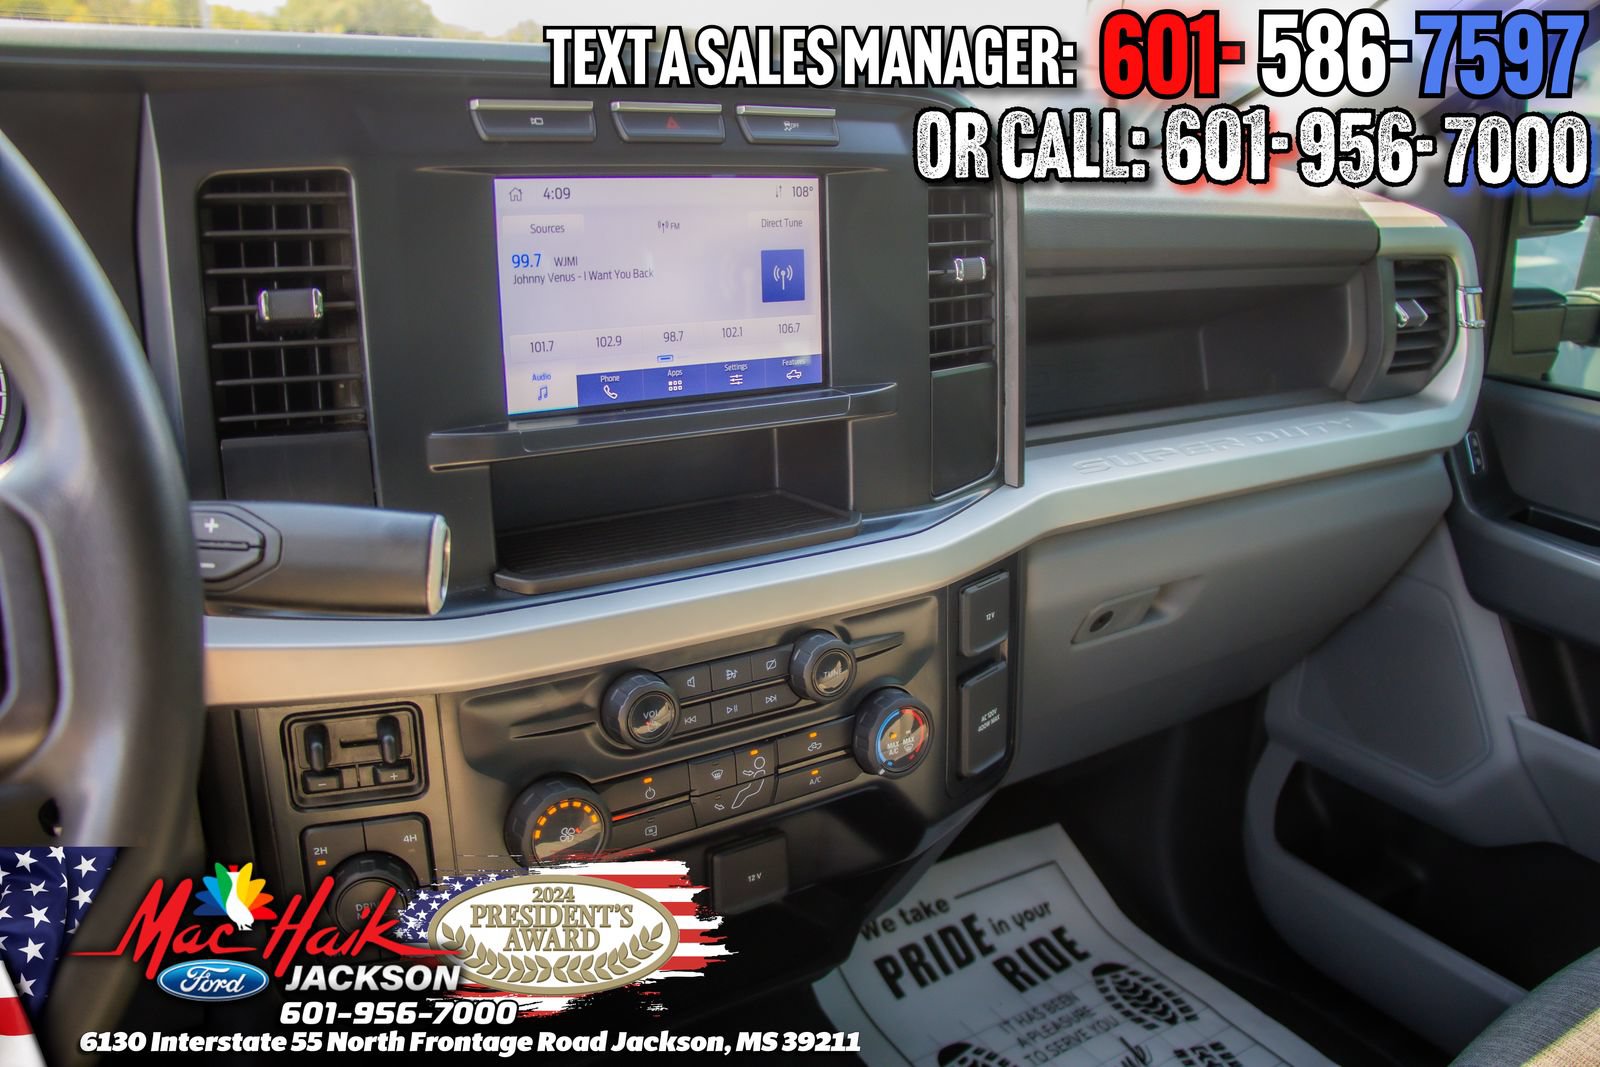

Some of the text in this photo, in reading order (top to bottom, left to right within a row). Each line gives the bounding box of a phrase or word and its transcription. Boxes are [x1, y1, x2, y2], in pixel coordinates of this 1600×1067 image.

[543, 187, 571, 200] 4:09
[670, 222, 680, 230] FM
[761, 217, 803, 228] Direct Tune
[530, 223, 565, 235] Sources
[511, 253, 578, 268] 99.7 WJMI
[513, 272, 545, 285] Johnny
[548, 271, 576, 283] Venus
[588, 269, 612, 281] Want
[613, 268, 631, 280] You
[633, 267, 654, 279] Back
[721, 326, 744, 338] 102.1
[778, 322, 801, 334] 106.7
[595, 335, 622, 348] 102.9
[663, 330, 684, 343] 98.7
[530, 340, 554, 353] 101.7
[724, 361, 748, 373] Settings
[782, 358, 806, 367] Features
[532, 372, 551, 382] Audio
[600, 373, 620, 383] Phone
[667, 368, 683, 379] Apps
[1071, 417, 1352, 475] SUPER DUTY
[809, 775, 822, 785] A/C
[403, 834, 417, 843] 4H
[313, 846, 328, 856] 2H
[860, 897, 951, 941] We take
[873, 902, 1052, 1000] PRIDE in your
[992, 925, 1091, 994] RIDE
[1000, 991, 1080, 1033] IT HAS BEEN
[1016, 1005, 1096, 1049] A PLEASURE
[1024, 1014, 1120, 1065] TO SERVE YOU
